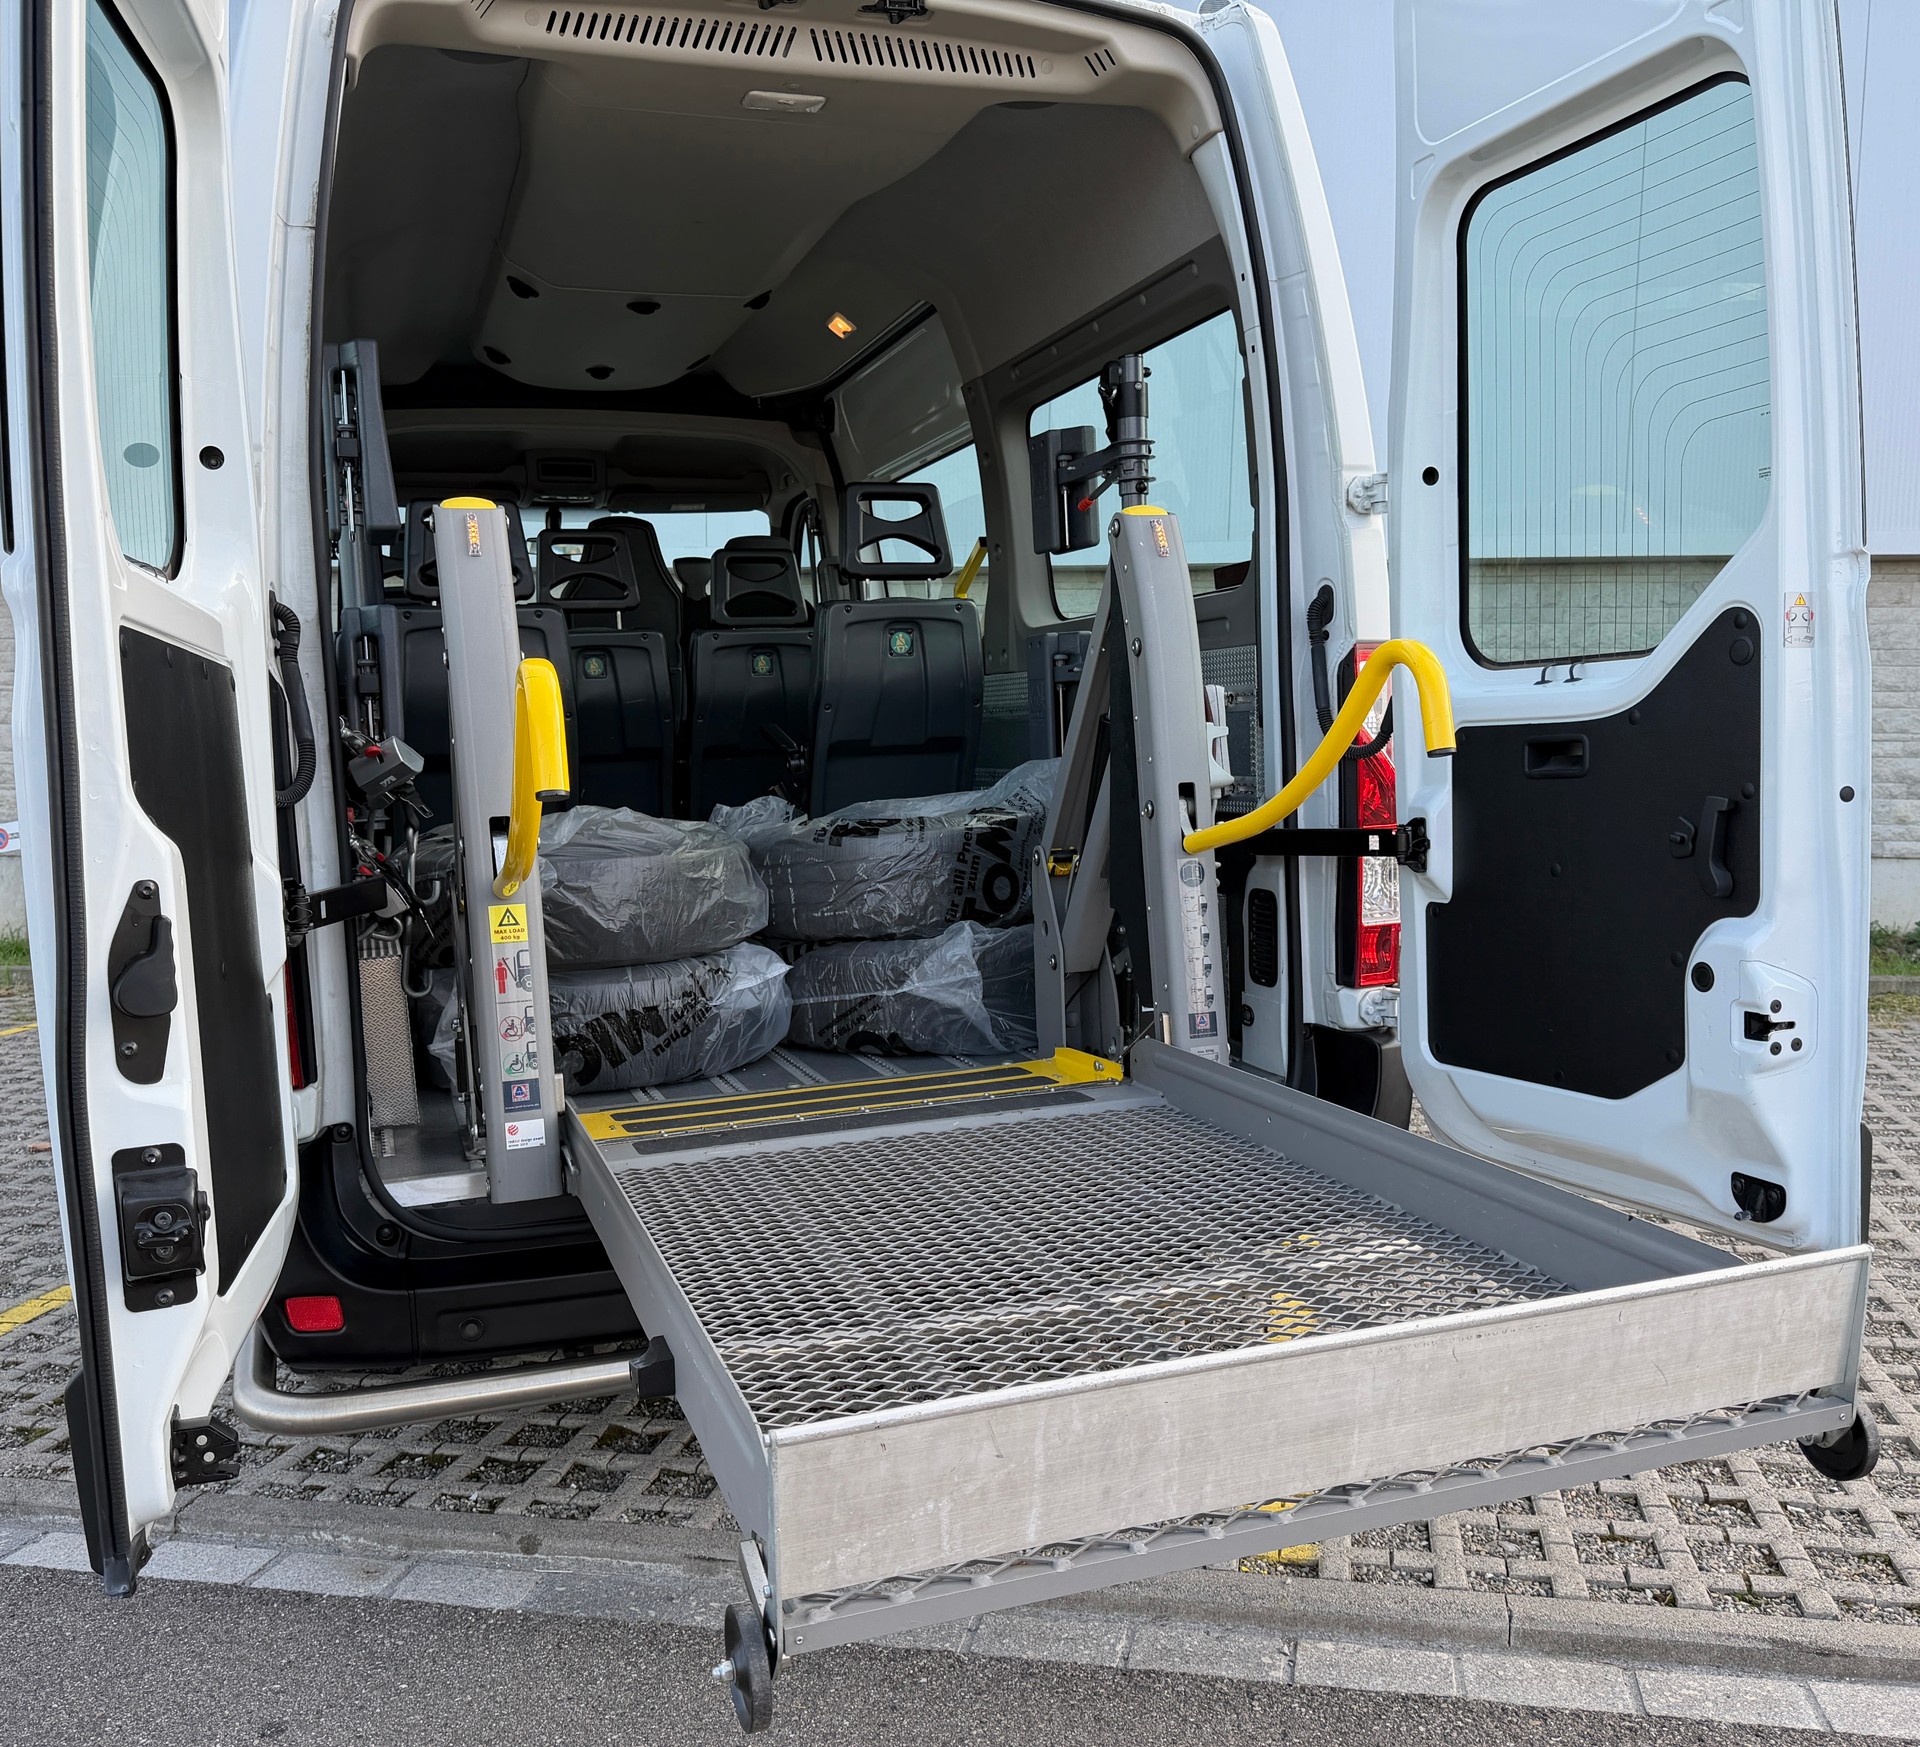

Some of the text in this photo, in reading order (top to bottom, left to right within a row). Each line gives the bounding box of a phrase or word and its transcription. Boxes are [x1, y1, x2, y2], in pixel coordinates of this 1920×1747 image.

[952, 869, 967, 897] alli
[966, 854, 981, 892] zum
[652, 1022, 692, 1057] Pneu
